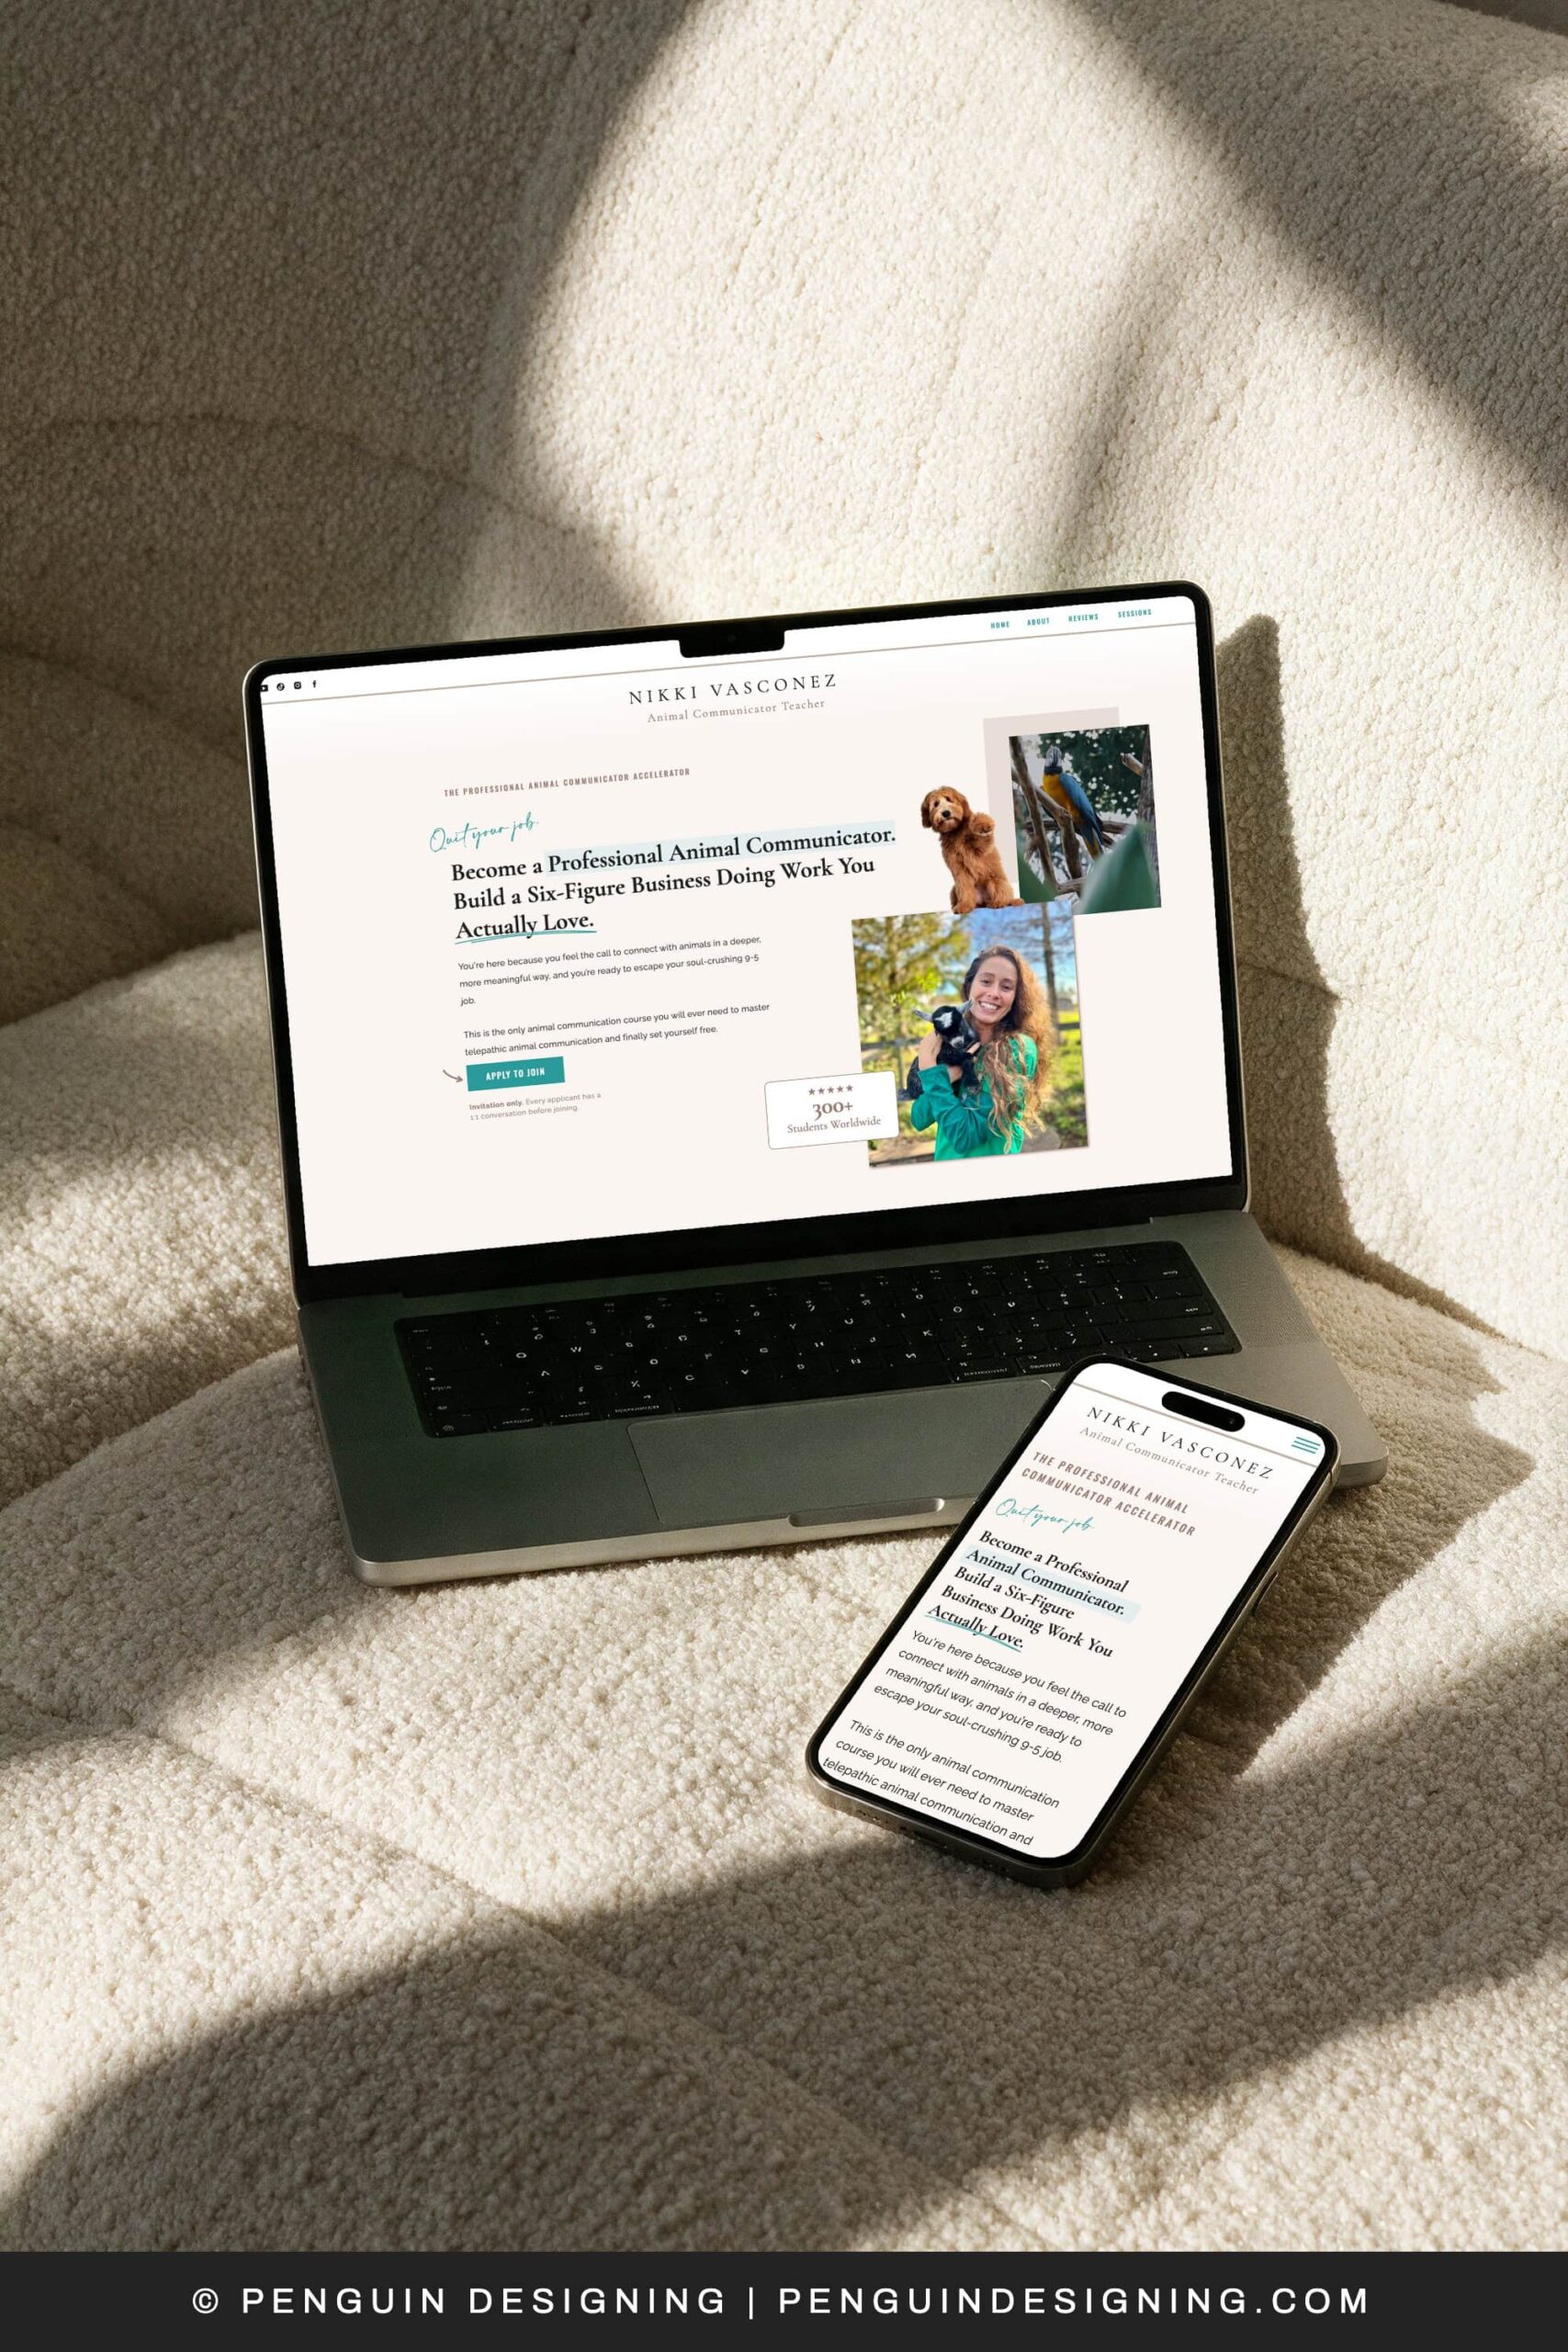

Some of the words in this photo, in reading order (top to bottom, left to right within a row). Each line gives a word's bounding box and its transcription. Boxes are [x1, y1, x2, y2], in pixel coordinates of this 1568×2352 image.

[990, 620, 1010, 629] HOME
[1026, 616, 1050, 626] ABOUT
[1067, 613, 1099, 623] REVIEWS
[1117, 608, 1152, 618] SESSIONS
[628, 685, 697, 706] NIKKI
[709, 673, 836, 697] VASCONEZ
[647, 708, 689, 723] Animal
[692, 705, 777, 718] Communicator
[781, 698, 825, 711] Teacher
[443, 787, 459, 797] THE
[462, 783, 525, 796] PROFESSIONAL
[528, 779, 559, 790] ANIMAL
[562, 773, 629, 786] COMMUNICATOR
[632, 767, 690, 781] ACCELERATOR
[430, 823, 477, 853] Quit
[472, 826, 510, 850] your
[451, 864, 527, 881] Become
[532, 862, 544, 874] a
[548, 843, 663, 873] Professional
[668, 836, 740, 862] Animal
[746, 830, 896, 854] Communicator.
[453, 886, 506, 910] Build
[511, 892, 523, 905] a
[527, 881, 626, 905] Six-Figure
[630, 874, 712, 894] Business
[716, 866, 776, 888] Doing
[779, 856, 834, 879] Work
[838, 856, 875, 875] You
[456, 914, 537, 939] Actually
[544, 913, 593, 931] Love.
[457, 961, 485, 971] You're
[485, 959, 506, 968] here
[506, 956, 544, 967] because
[544, 955, 561, 965] you
[561, 951, 580, 961] feel
[580, 951, 595, 960] the
[595, 948, 612, 958] call
[612, 948, 622, 957] to
[623, 944, 659, 956] connect
[659, 943, 678, 953] with
[678, 940, 712, 951] animals
[712, 939, 721, 947] in
[729, 936, 761, 946] deeper,
[458, 979, 482, 989] more
[482, 973, 532, 986] meaningful
[552, 970, 570, 979] and
[570, 968, 596, 979] you're
[597, 966, 622, 976] ready
[622, 965, 633, 973] to
[633, 962, 664, 972] escape
[665, 961, 684, 971] your
[685, 955, 743, 967] soul-crushing
[744, 953, 760, 963] 9-5
[459, 996, 477, 1007] job.
[463, 1030, 481, 1039] This
[482, 1029, 491, 1037] is
[491, 1028, 506, 1037] the
[507, 1025, 526, 1035] only
[527, 1023, 556, 1034] animal
[557, 1017, 622, 1031] communication
[623, 1015, 652, 1024] course
[653, 1013, 670, 1023] you
[670, 1010, 686, 1020] will
[686, 1010, 705, 1018] ever
[706, 1006, 729, 1016] need
[729, 1006, 739, 1014] to
[740, 1003, 770, 1013] master
[464, 1045, 507, 1057] telepathic
[508, 1041, 537, 1053] animal
[537, 1036, 604, 1049] communication
[604, 1034, 621, 1044] and
[621, 1031, 649, 1042] finally
[649, 1030, 663, 1039] set
[663, 1025, 698, 1040] yourself
[699, 1025, 718, 1035] free.
[485, 1069, 511, 1081] APPLY
[513, 1069, 525, 1079] TO
[526, 1067, 546, 1078] JOIN
[786, 1122, 829, 1134] Students
[829, 1115, 882, 1129] Worldwide
[812, 1101, 853, 1120] 300+
[1078, 1426, 1124, 1448] Animal
[1124, 1442, 1211, 1477] Communicator
[1214, 1471, 1259, 1495] Teacher
[1086, 1406, 1151, 1437] NIKKI
[1161, 1430, 1274, 1480] VASCONEZ
[1021, 1467, 1113, 1507] COMMUNICATOR
[1114, 1500, 1196, 1536] ACCELERATOR
[1032, 1451, 1055, 1466] THE
[1056, 1460, 1142, 1498] PROFESSIONAL
[1144, 1491, 1189, 1514] ANIMAL
[965, 1549, 1021, 1576] Animal
[1021, 1567, 1124, 1615] Communicator.
[978, 1530, 1033, 1559] Become
[1032, 1554, 1043, 1563] a
[1043, 1554, 1130, 1593] Professional
[953, 1566, 996, 1589] Build
[992, 1584, 1003, 1593] a
[1004, 1584, 1076, 1620] Six-Figure
[928, 1604, 987, 1636] Actually
[988, 1625, 1023, 1648] Love.
[941, 1584, 999, 1615] Business
[999, 1606, 1044, 1635] Doing
[1048, 1622, 1085, 1647] Work
[1088, 1637, 1114, 1657] You
[897, 1649, 945, 1673] connect
[945, 1667, 970, 1682] with
[969, 1677, 1016, 1699] animals
[1015, 1690, 1028, 1704] in
[1027, 1698, 1037, 1707] a
[1037, 1701, 1081, 1724] deeper,
[1081, 1718, 1114, 1736] more
[912, 1629, 946, 1651] You're
[946, 1643, 974, 1661] here
[973, 1653, 1023, 1679] because
[1021, 1673, 1046, 1688] you
[1045, 1680, 1071, 1698] feel
[1069, 1690, 1090, 1704] the
[1090, 1700, 1114, 1713] call
[1113, 1705, 1127, 1718] to
[874, 1685, 916, 1706] escape
[913, 1700, 943, 1716] your
[942, 1711, 1021, 1748] soul-crushing
[1020, 1740, 1043, 1756] 9-5
[1038, 1747, 1062, 1763] job.
[885, 1668, 951, 1698] meaningful
[975, 1702, 1001, 1716] and
[998, 1710, 1034, 1729] you're
[1034, 1724, 1070, 1744] ready
[1068, 1735, 1083, 1747] to
[835, 1740, 875, 1760] course
[873, 1755, 898, 1770] you
[898, 1763, 921, 1779] will
[919, 1772, 947, 1788] ever
[946, 1782, 979, 1801] need
[977, 1792, 992, 1806] to
[992, 1800, 1035, 1822] master
[850, 1719, 874, 1736] This
[873, 1729, 885, 1741] is
[885, 1734, 906, 1749] the
[906, 1744, 932, 1760] only
[931, 1753, 973, 1775] animal
[971, 1769, 1060, 1809] communication
